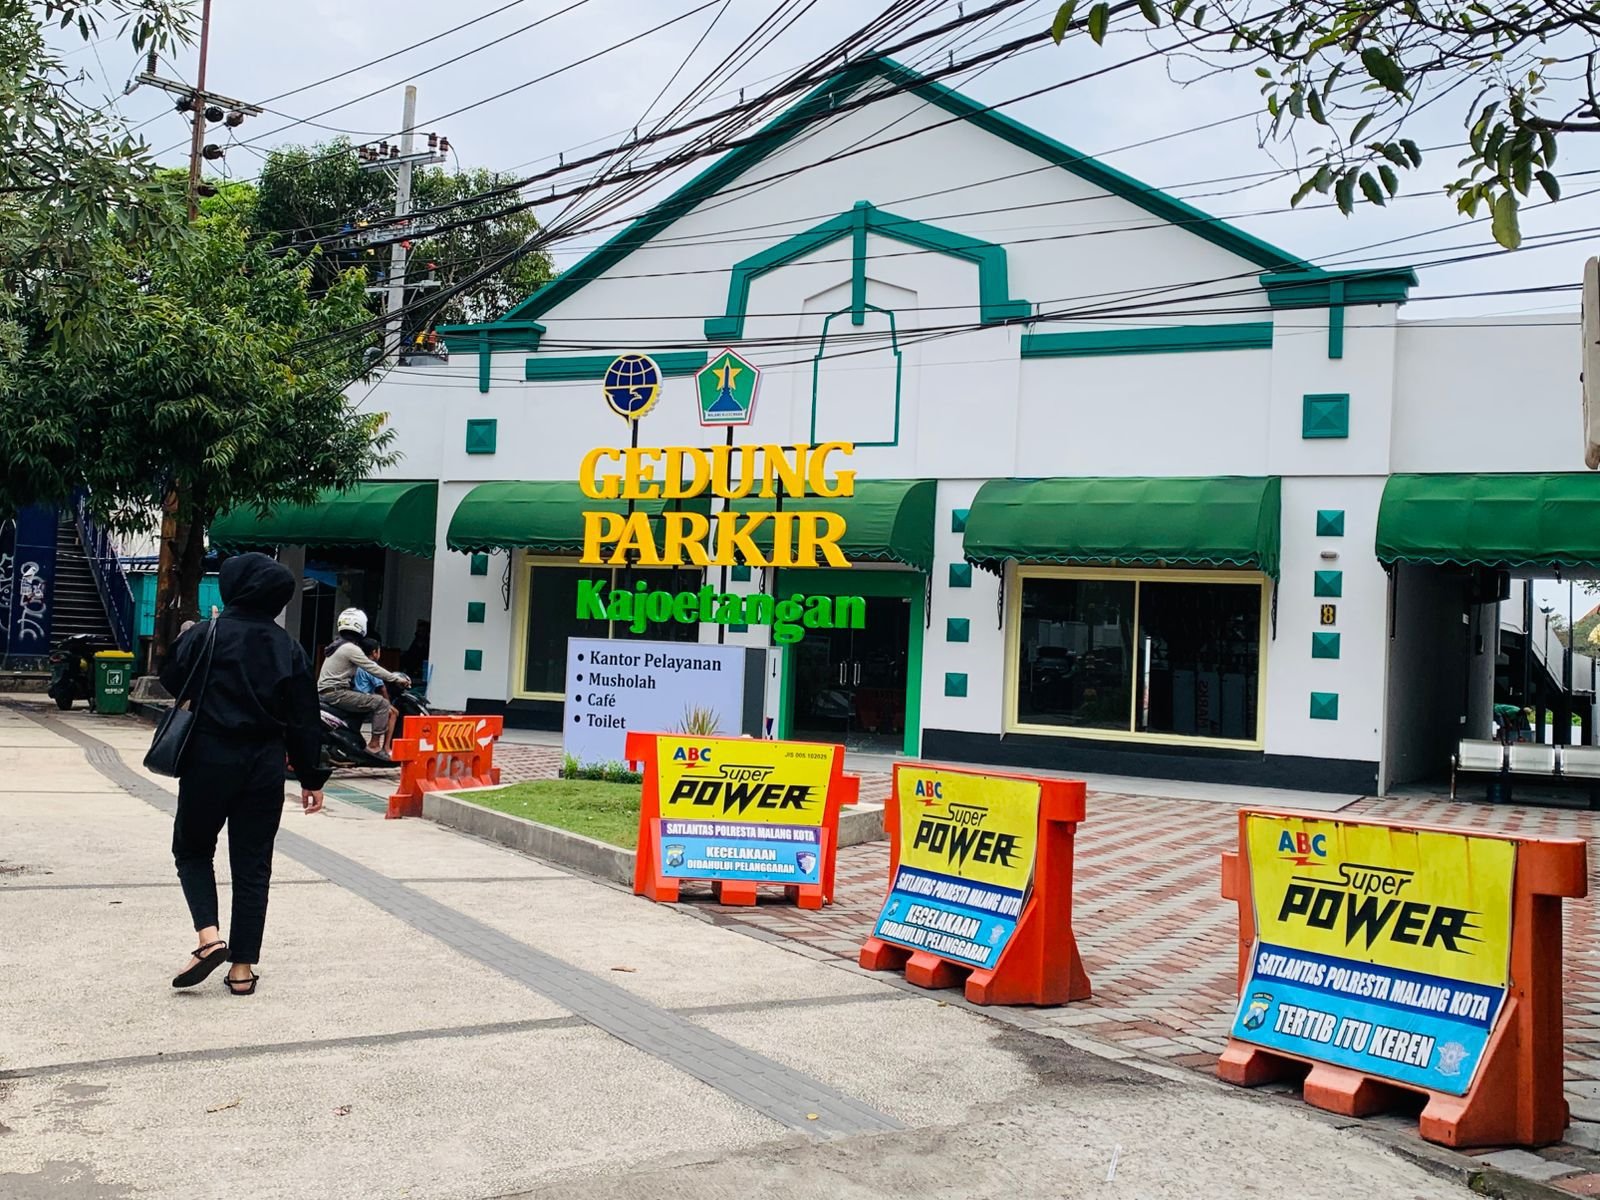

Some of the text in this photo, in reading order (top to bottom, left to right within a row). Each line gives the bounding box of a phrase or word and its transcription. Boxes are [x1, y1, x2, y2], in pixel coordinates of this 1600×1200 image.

[578, 441, 857, 499] GEDUNG
[579, 511, 852, 567] PARKIR
[576, 579, 866, 643] Kajoetangan
[1323, 606, 1334, 624] 8
[590, 650, 722, 672] Kantor Pelayanan
[588, 672, 656, 689] Musholah
[588, 693, 616, 707] Café
[587, 713, 626, 729] Toilet
[673, 747, 711, 762] ABC
[681, 764, 775, 783] Super
[669, 780, 819, 815] POWER
[915, 779, 942, 799] ABC
[922, 803, 989, 826] Super
[666, 823, 815, 842] SATLANTAS POLRESTA MALANG KOTA
[913, 820, 1024, 868] POWER
[1278, 830, 1327, 857] ABC
[687, 859, 795, 874] DIDAHULUI PELANGGARAN
[706, 846, 776, 861] KECELAKAAN
[1291, 863, 1415, 895] Super
[896, 873, 936, 897] SATLANTAS
[966, 888, 1002, 913] MALANG
[997, 895, 1022, 917] KOTA
[905, 904, 981, 940] KECELAKAAN
[1278, 884, 1485, 955] POWER
[880, 919, 992, 963] DIDAHULUI PELANGGARAN
[1257, 952, 1490, 1021] SATLANTAS POLRESTA MALANG KOTA
[1273, 1003, 1436, 1068] TERTIB ITU KEREN
